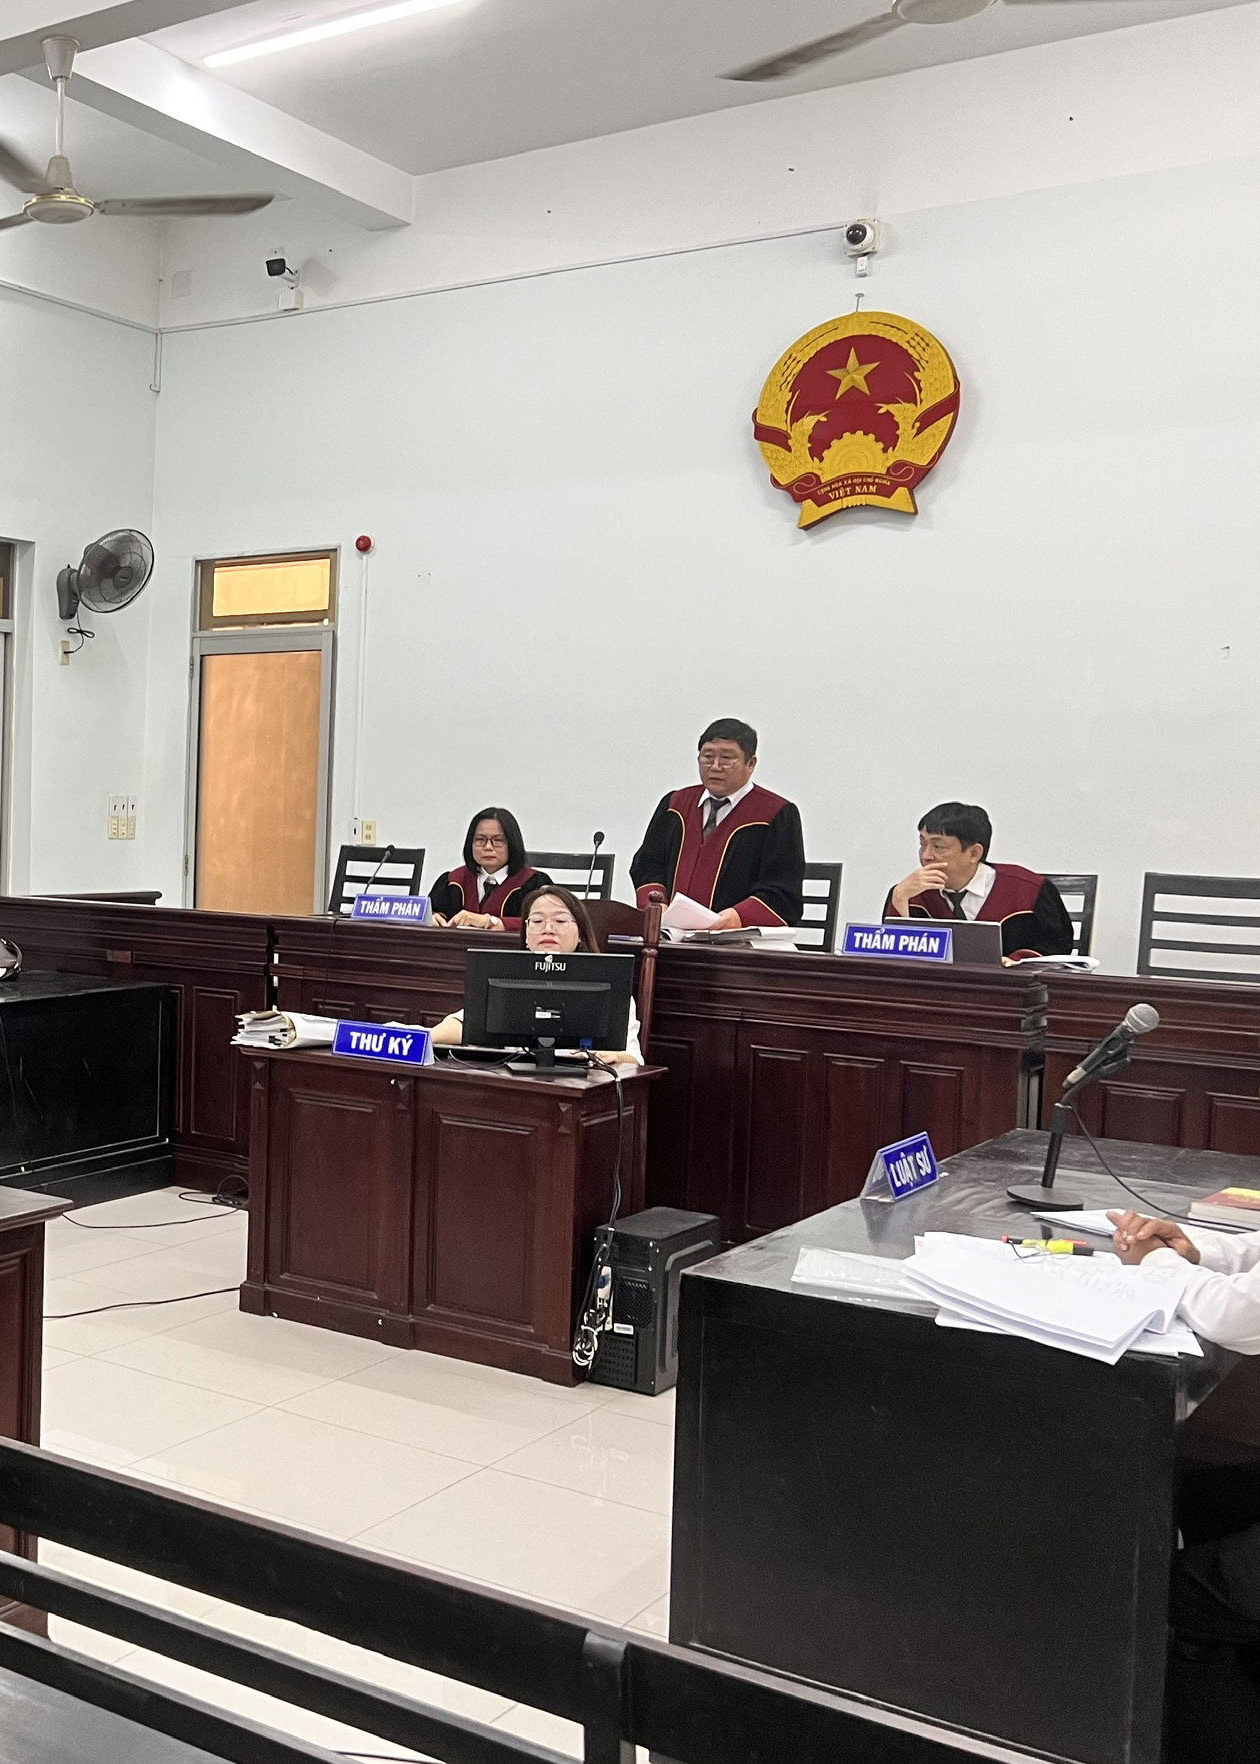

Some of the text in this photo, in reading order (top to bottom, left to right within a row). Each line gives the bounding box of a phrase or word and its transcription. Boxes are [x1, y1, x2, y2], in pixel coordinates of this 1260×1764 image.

[828, 485, 877, 499] VIỆT NAM
[360, 896, 421, 917] THẨM PHÁN
[853, 928, 940, 953] THẨM PHÁN
[535, 961, 566, 972] FUJITSU
[350, 1031, 413, 1056] THƯ KÝ
[889, 1145, 932, 1188] LUẬT SƯ
